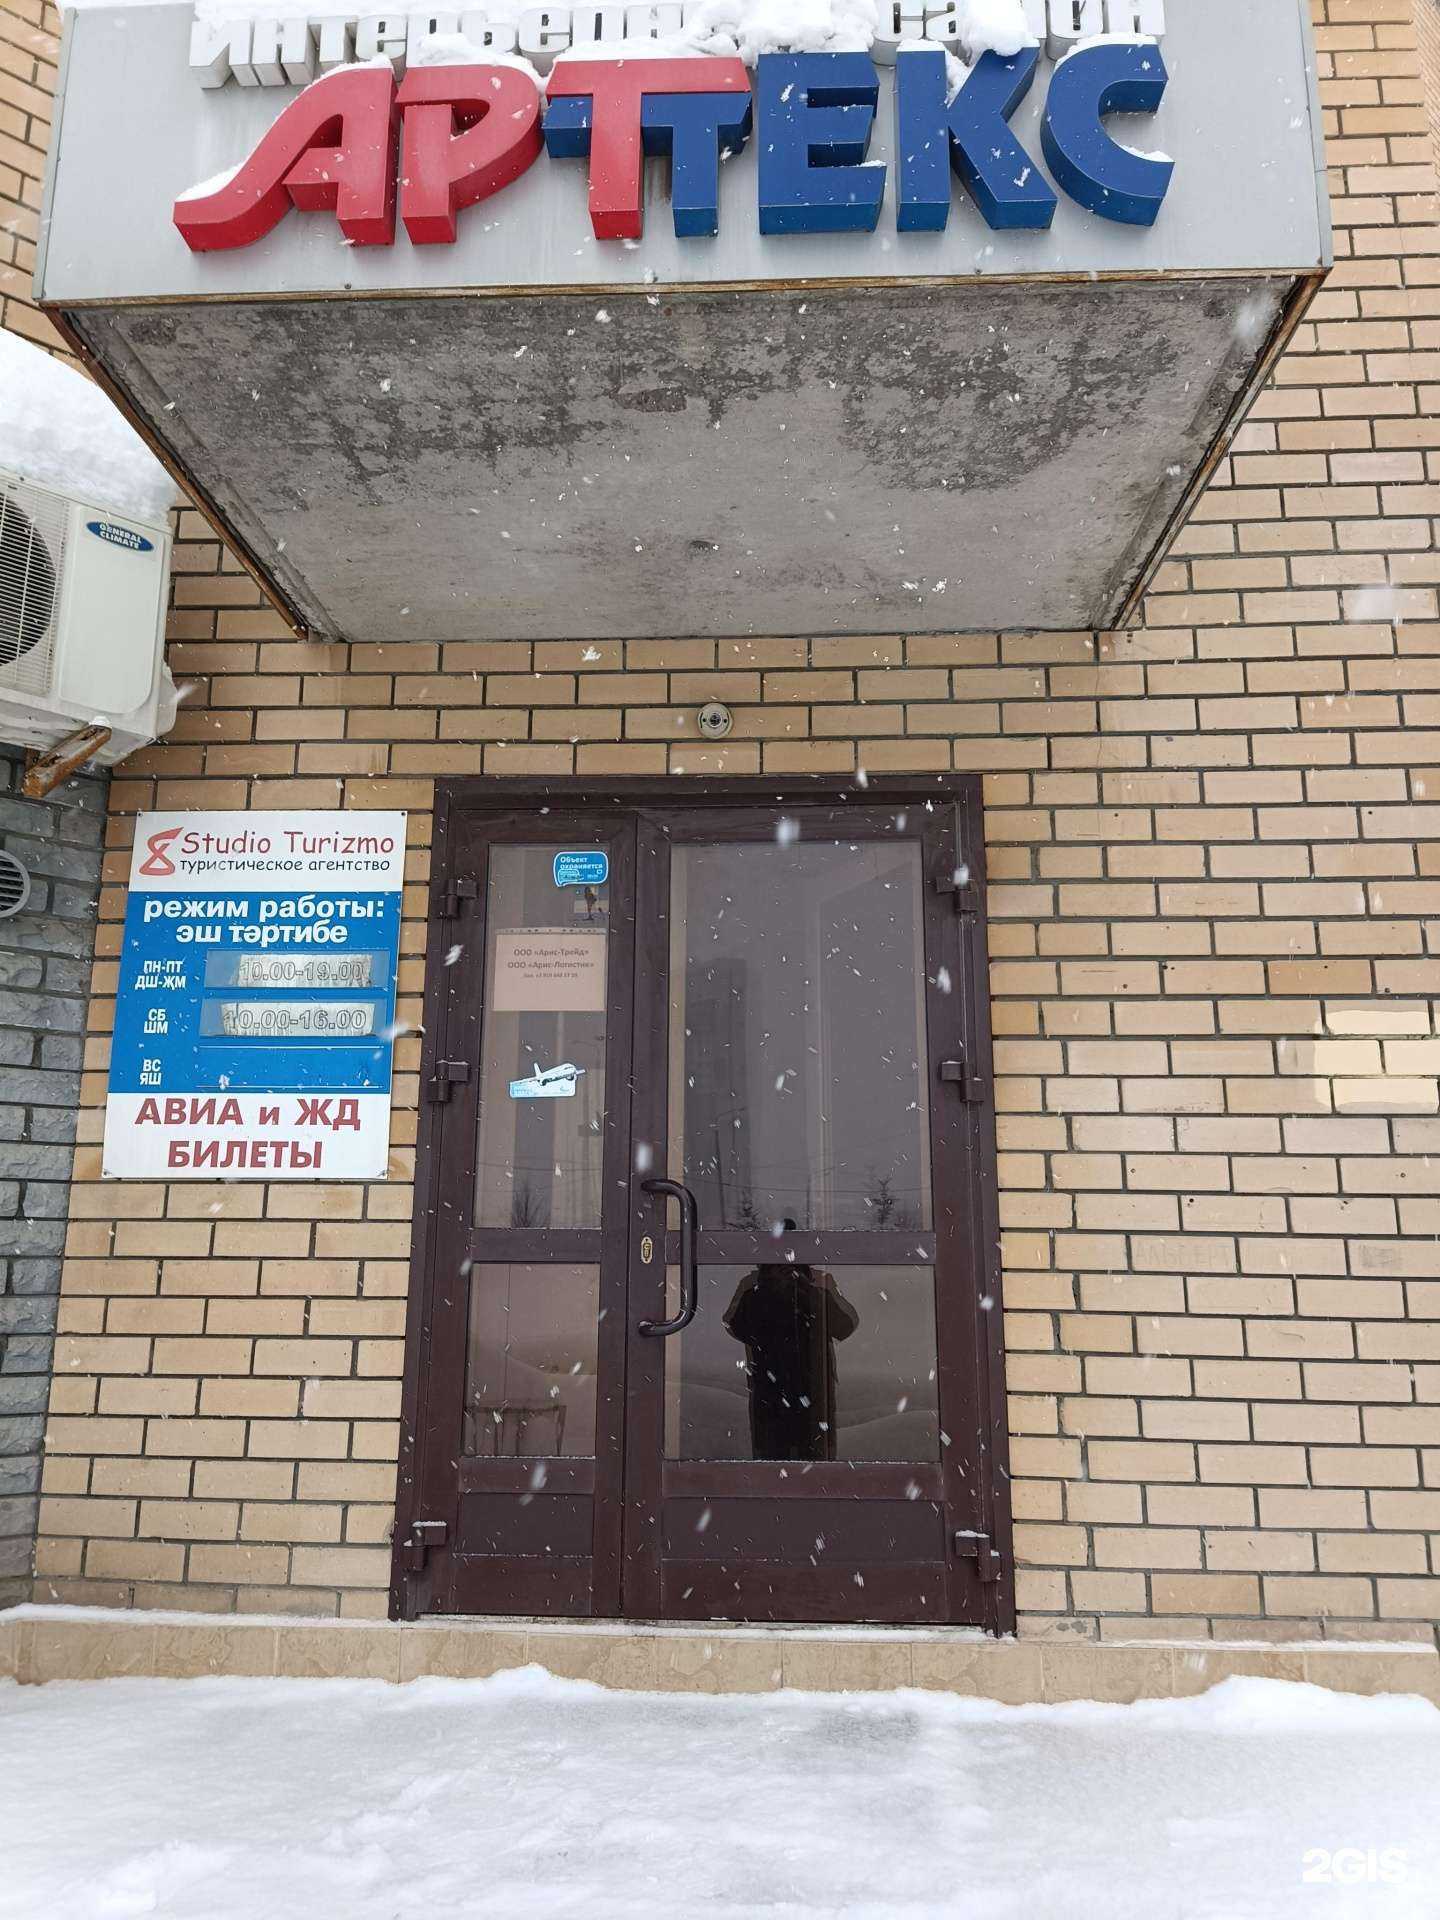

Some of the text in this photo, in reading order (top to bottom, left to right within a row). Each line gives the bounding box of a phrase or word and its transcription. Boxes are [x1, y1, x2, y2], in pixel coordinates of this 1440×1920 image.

[99, 522, 142, 544] GENERAL
[100, 530, 140, 549] CLIMATE
[181, 831, 394, 854] Studio Turizmo
[180, 858, 391, 877] туристическое агентство
[144, 894, 384, 922] режим работы:
[176, 919, 349, 948] эш тәртибе
[143, 959, 184, 974] ПН-ПТ
[240, 961, 365, 981] 10.00-19.00
[147, 1008, 167, 1021] СБ
[223, 1009, 367, 1030] 10.00-16.00
[144, 1020, 168, 1034] ШМ
[142, 1059, 162, 1072] ВС
[139, 1072, 162, 1086] ЯШ
[134, 1098, 361, 1131] АВИА и ЖД
[167, 1140, 323, 1169] БИЛЕТЫ
